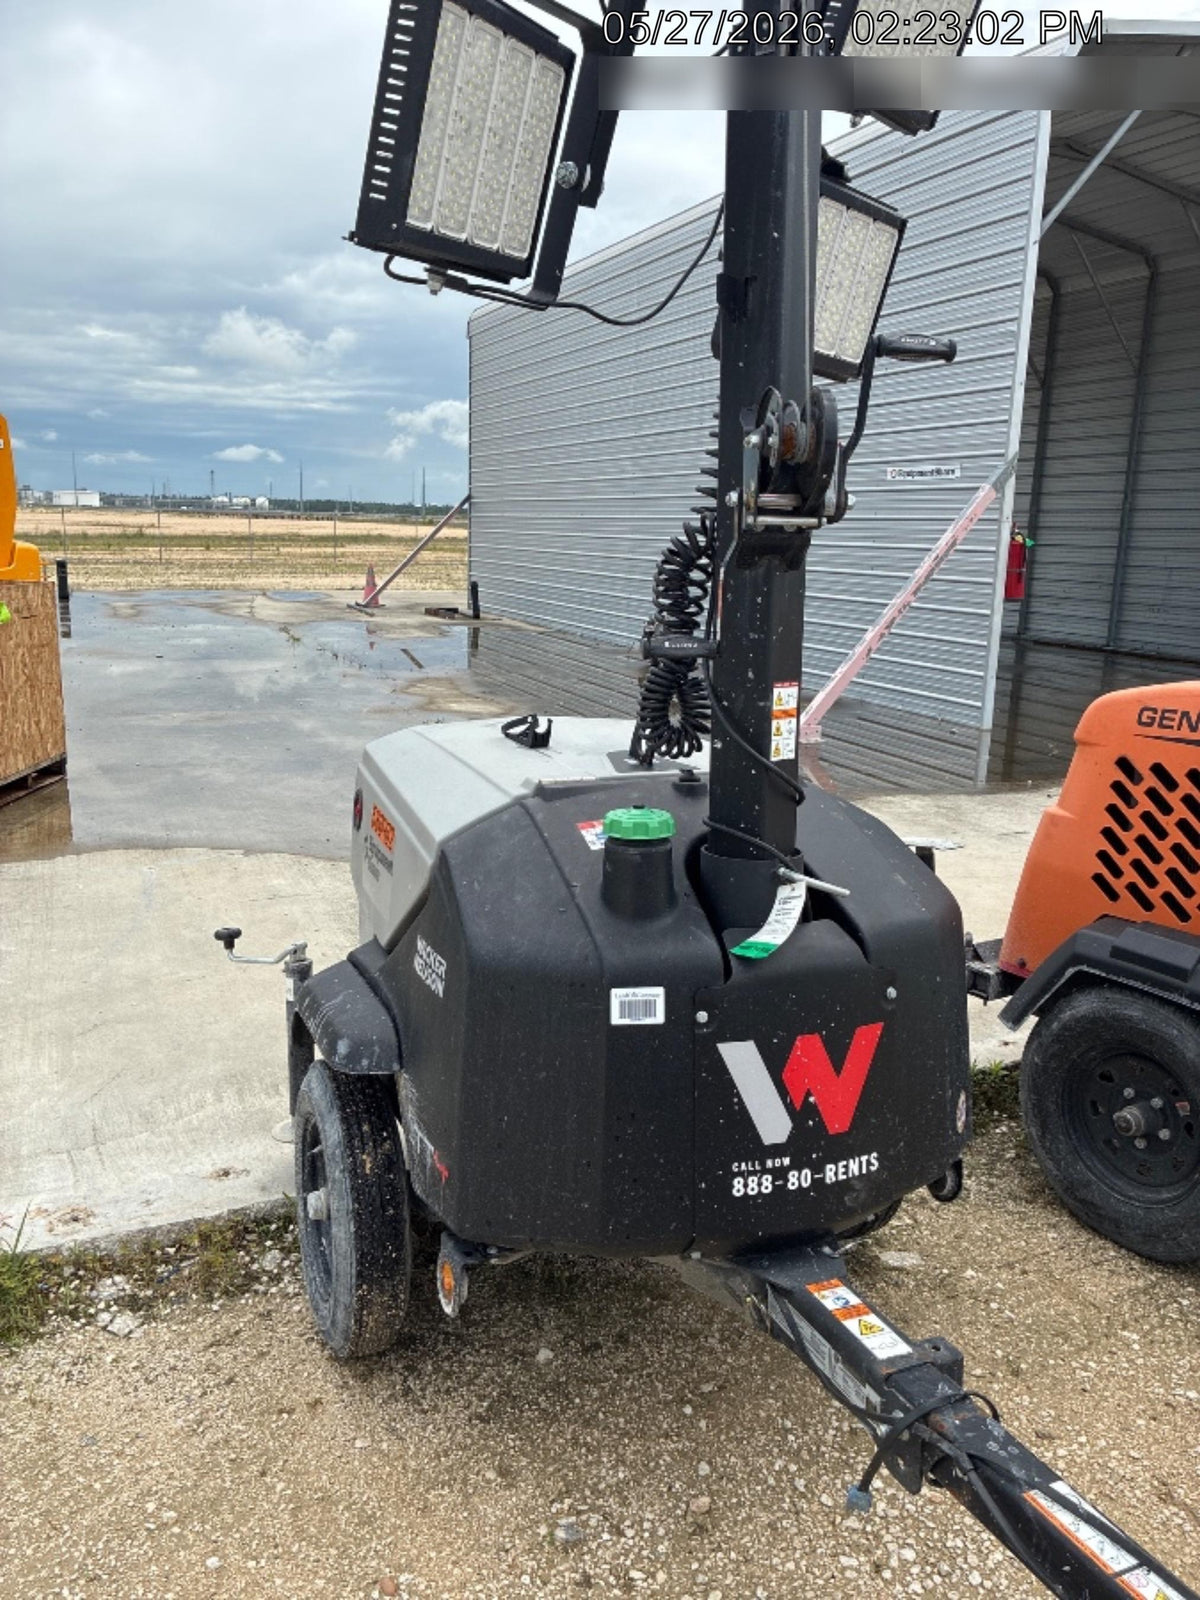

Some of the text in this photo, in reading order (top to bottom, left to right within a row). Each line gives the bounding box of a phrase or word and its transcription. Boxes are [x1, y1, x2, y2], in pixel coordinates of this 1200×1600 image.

[1137, 706, 1200, 733] GEN
[732, 1156, 791, 1172] CALL NOW
[732, 1151, 879, 1197] 888-80-RENTS
